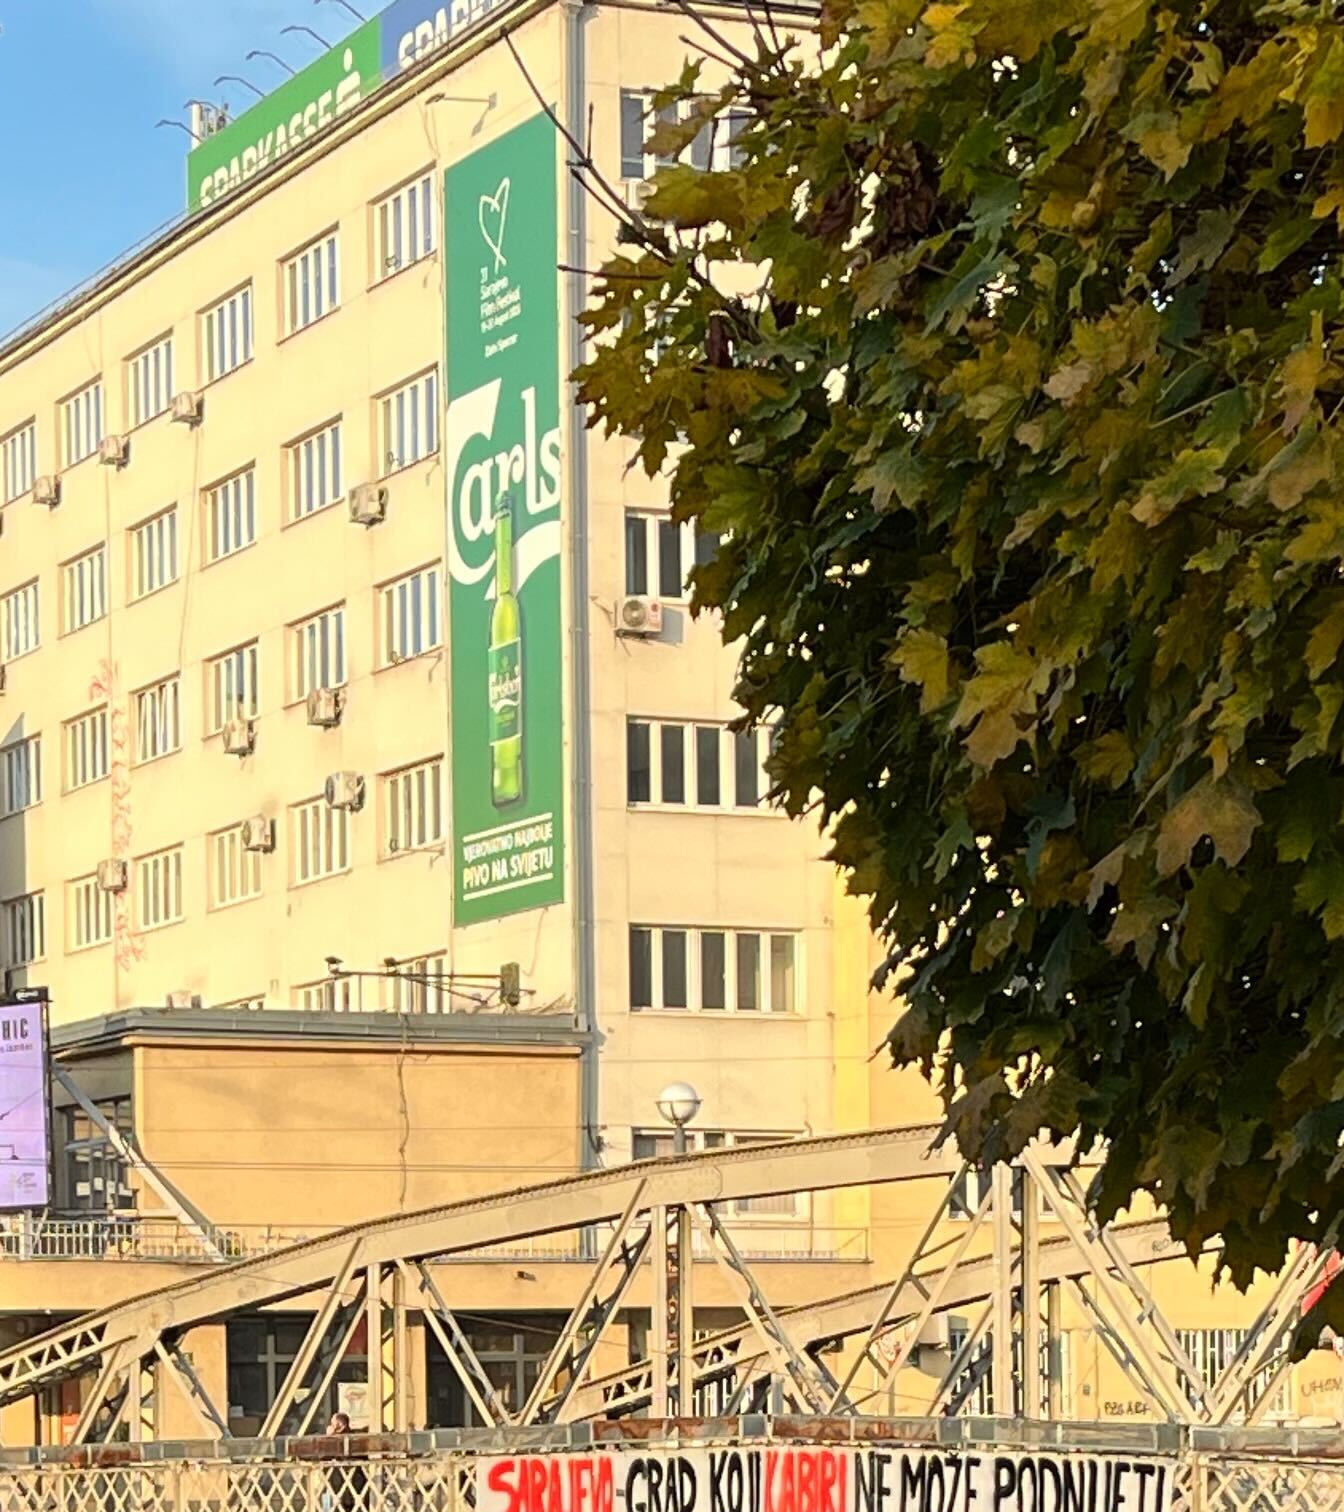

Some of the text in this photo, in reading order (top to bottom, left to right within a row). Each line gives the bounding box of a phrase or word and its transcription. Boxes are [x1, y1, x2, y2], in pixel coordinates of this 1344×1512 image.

[463, 846, 553, 890] PIVO NA SVIJETU
